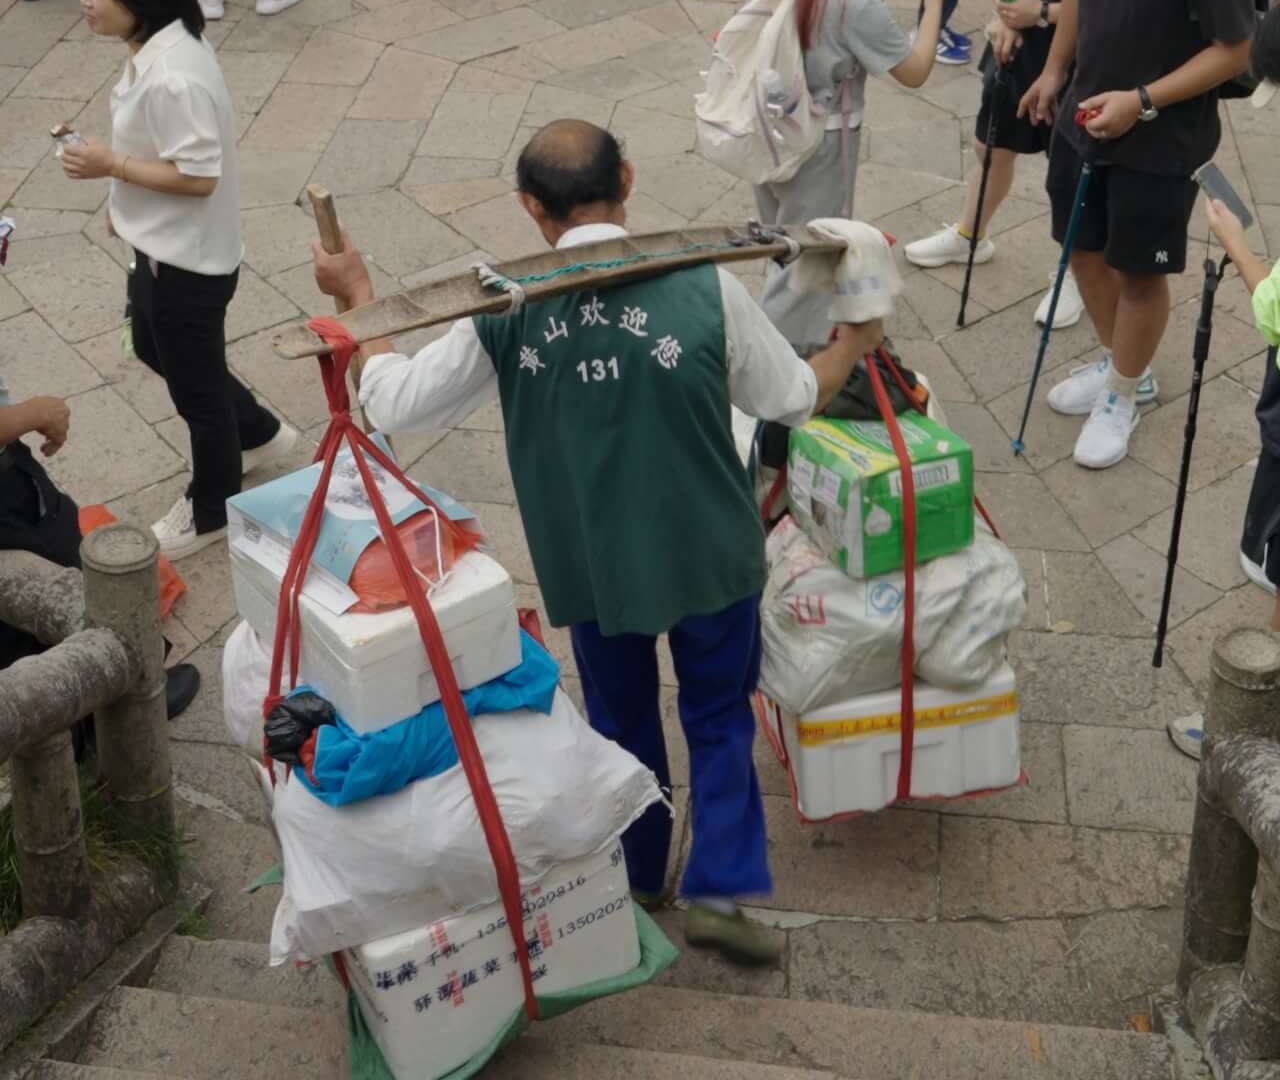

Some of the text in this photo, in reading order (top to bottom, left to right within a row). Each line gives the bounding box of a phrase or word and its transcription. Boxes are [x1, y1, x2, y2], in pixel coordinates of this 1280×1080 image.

[519, 295, 684, 376] 黄山欢迎您
[576, 356, 620, 384] 131
